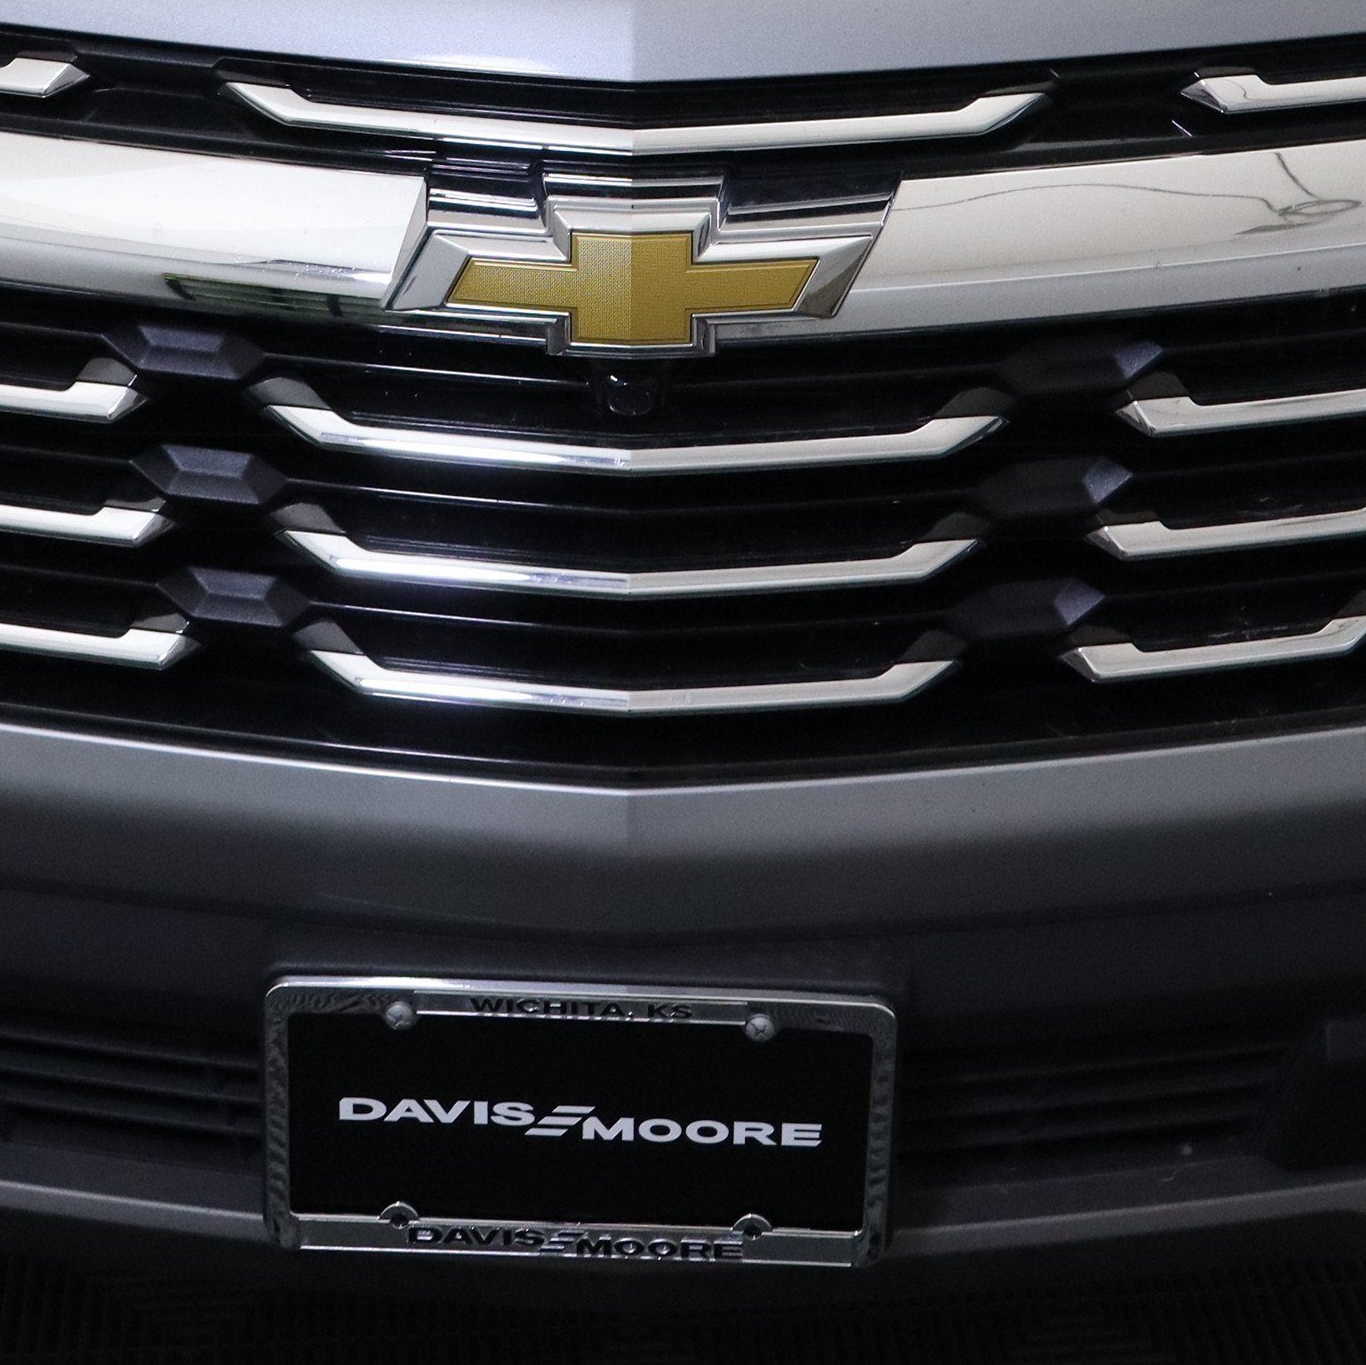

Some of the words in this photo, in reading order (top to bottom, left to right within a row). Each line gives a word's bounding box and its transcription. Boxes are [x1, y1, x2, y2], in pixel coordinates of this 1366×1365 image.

[647, 1003, 693, 1019] KS
[339, 1097, 534, 1126] DAVIS
[582, 1118, 822, 1147] MOORE
[408, 1226, 544, 1247] DAVIS
[576, 1235, 744, 1260] MOORE
